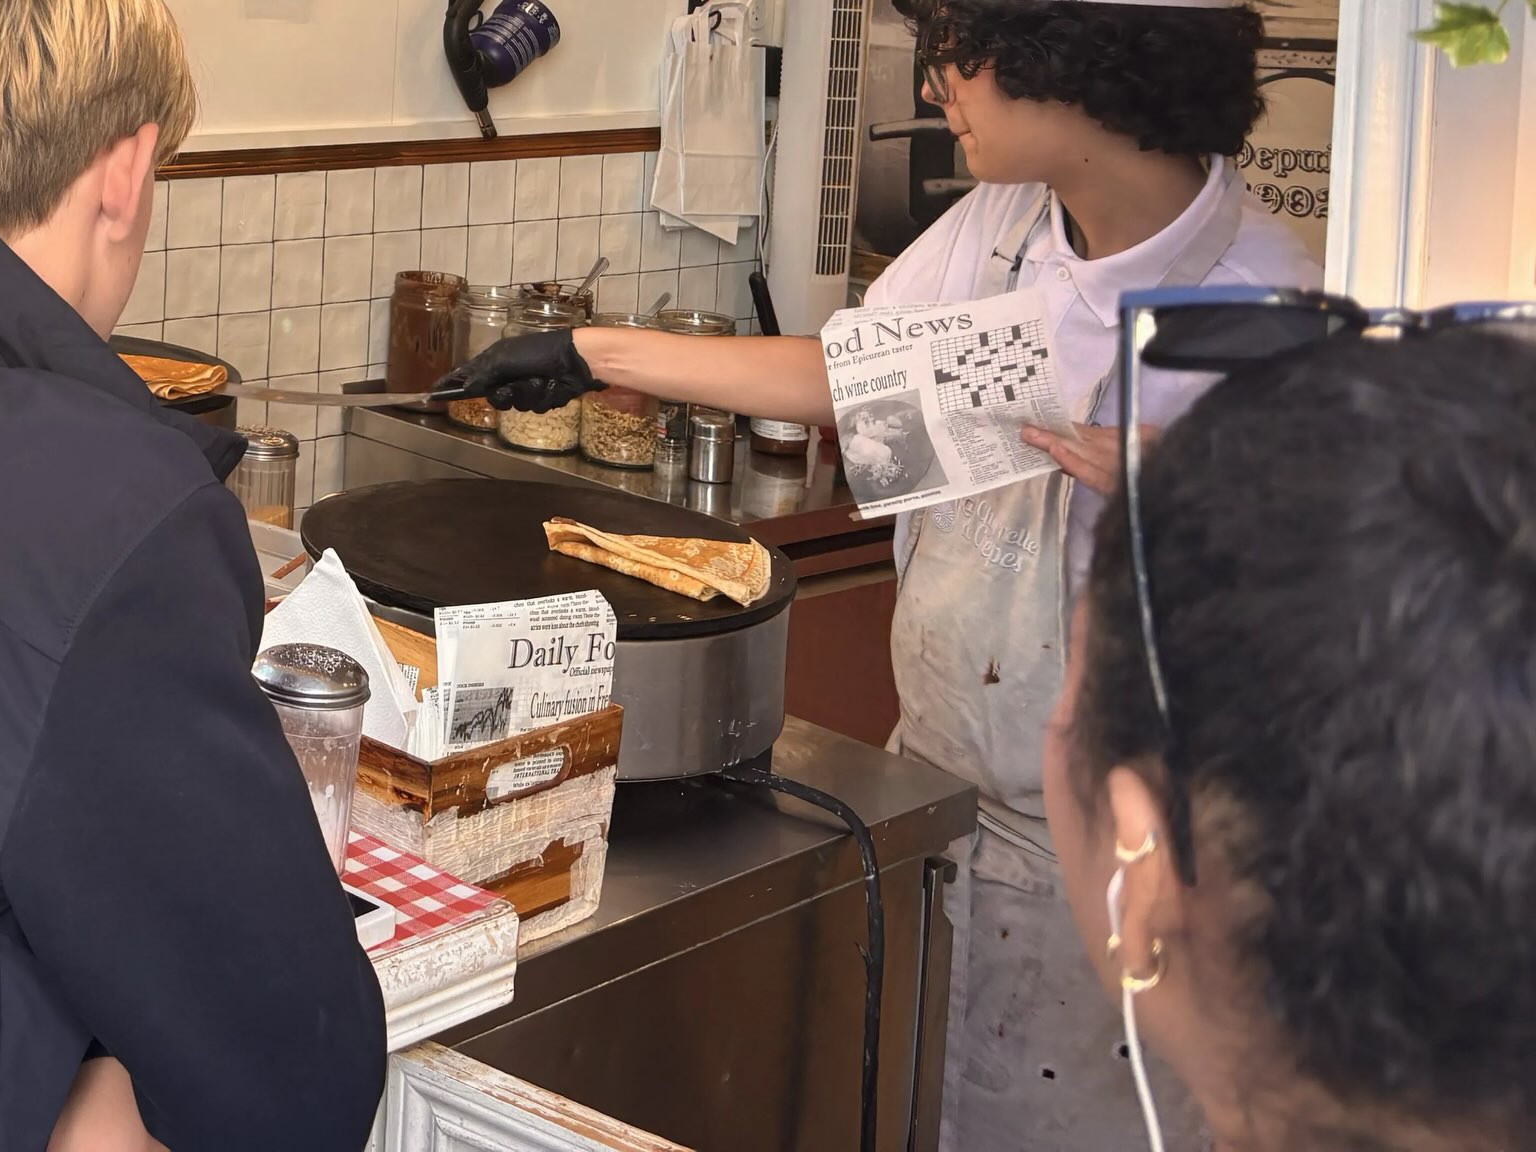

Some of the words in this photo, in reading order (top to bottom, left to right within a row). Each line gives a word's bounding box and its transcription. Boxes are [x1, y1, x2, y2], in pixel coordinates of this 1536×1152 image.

[826, 327, 864, 359] od
[872, 314, 973, 347] News
[834, 358, 851, 370] from
[852, 350, 890, 365] Epicurean
[892, 344, 913, 354] taster
[833, 379, 844, 402] ch
[845, 377, 869, 398] wine
[871, 369, 907, 393] country
[508, 635, 579, 674] Daily
[585, 633, 616, 662] Fo
[570, 666, 590, 677] Official
[531, 692, 564, 721] Culinary
[564, 689, 586, 715] fusion
[587, 689, 595, 711] in
